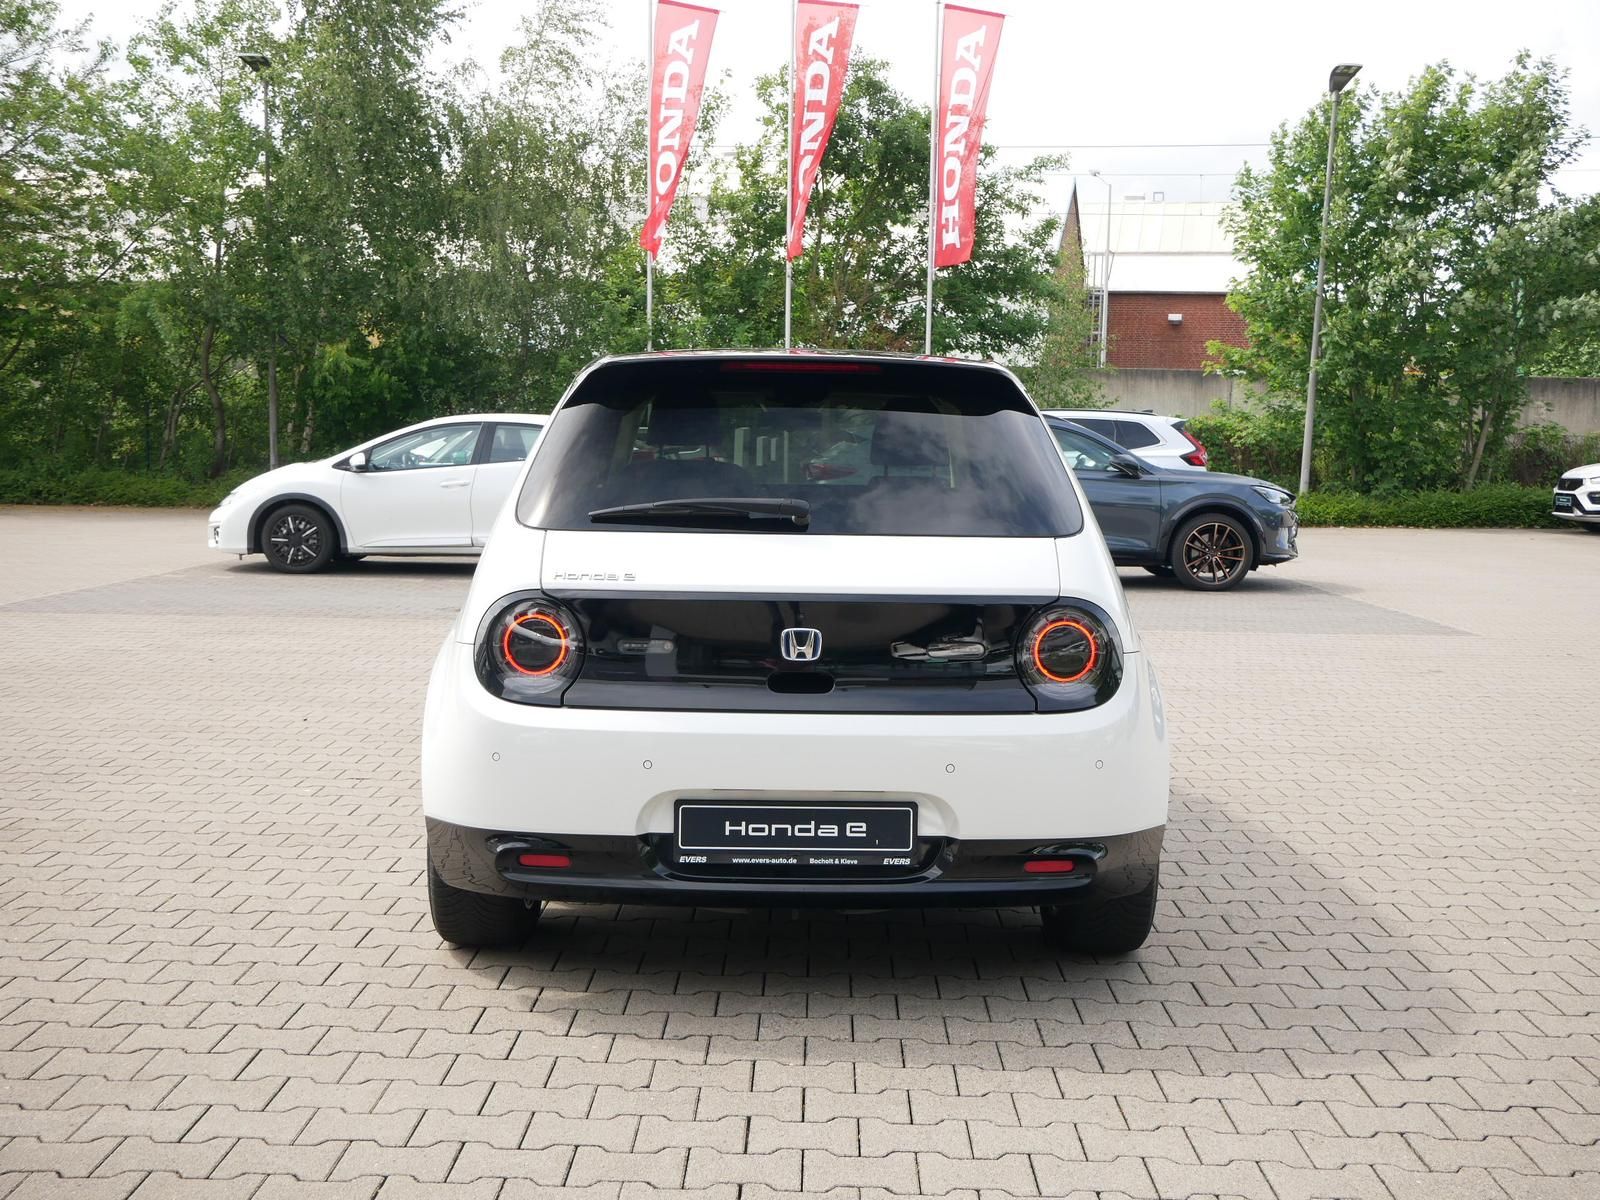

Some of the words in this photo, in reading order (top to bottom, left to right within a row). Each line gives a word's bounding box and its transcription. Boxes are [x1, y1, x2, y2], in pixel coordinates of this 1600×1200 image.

[942, 25, 987, 250] HONDA
[552, 571, 619, 581] Honda
[725, 820, 838, 837] Honda
[846, 822, 867, 837] e
[809, 857, 834, 865] Bocholt
